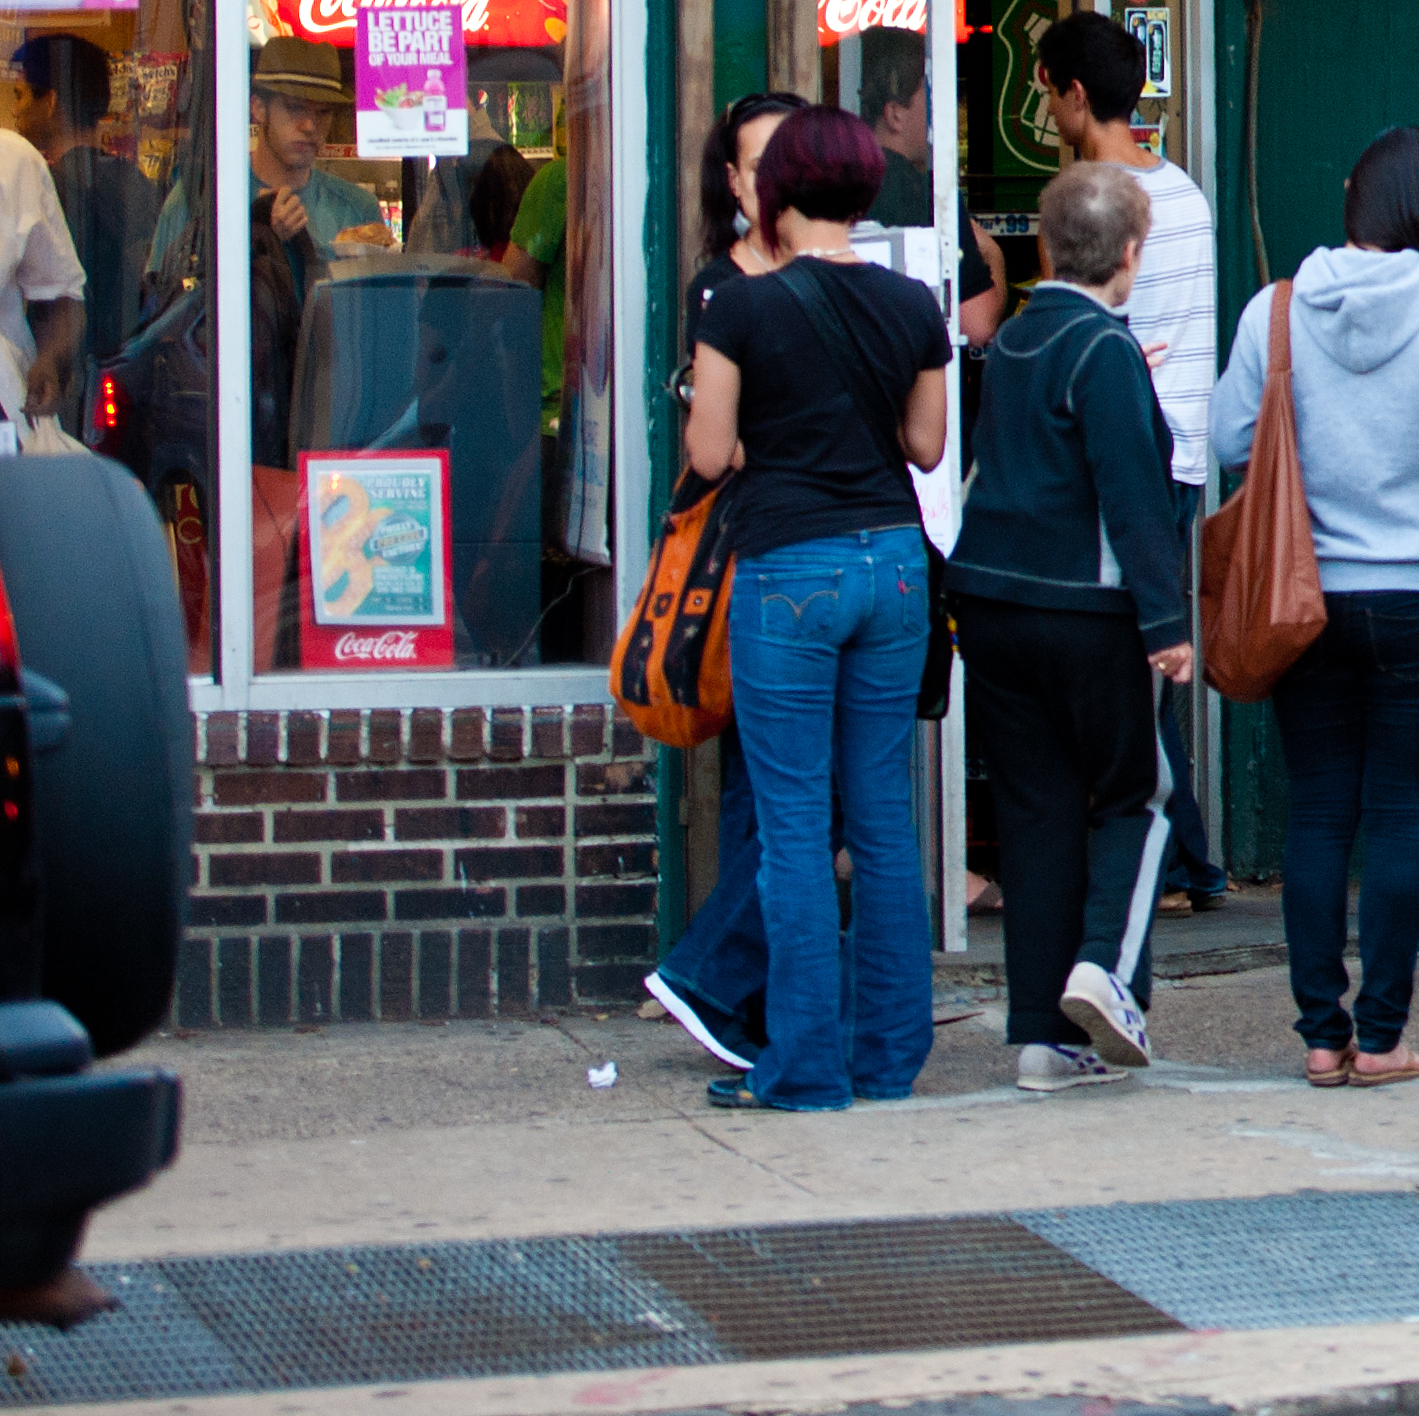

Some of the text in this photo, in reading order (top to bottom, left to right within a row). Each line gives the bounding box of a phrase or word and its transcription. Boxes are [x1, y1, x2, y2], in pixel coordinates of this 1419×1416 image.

[367, 10, 453, 32] LETTUCE
[368, 31, 453, 53] BE PART
[368, 52, 385, 67] OF
[387, 52, 419, 66] YOUR
[334, 631, 418, 661] Coca-Cola
